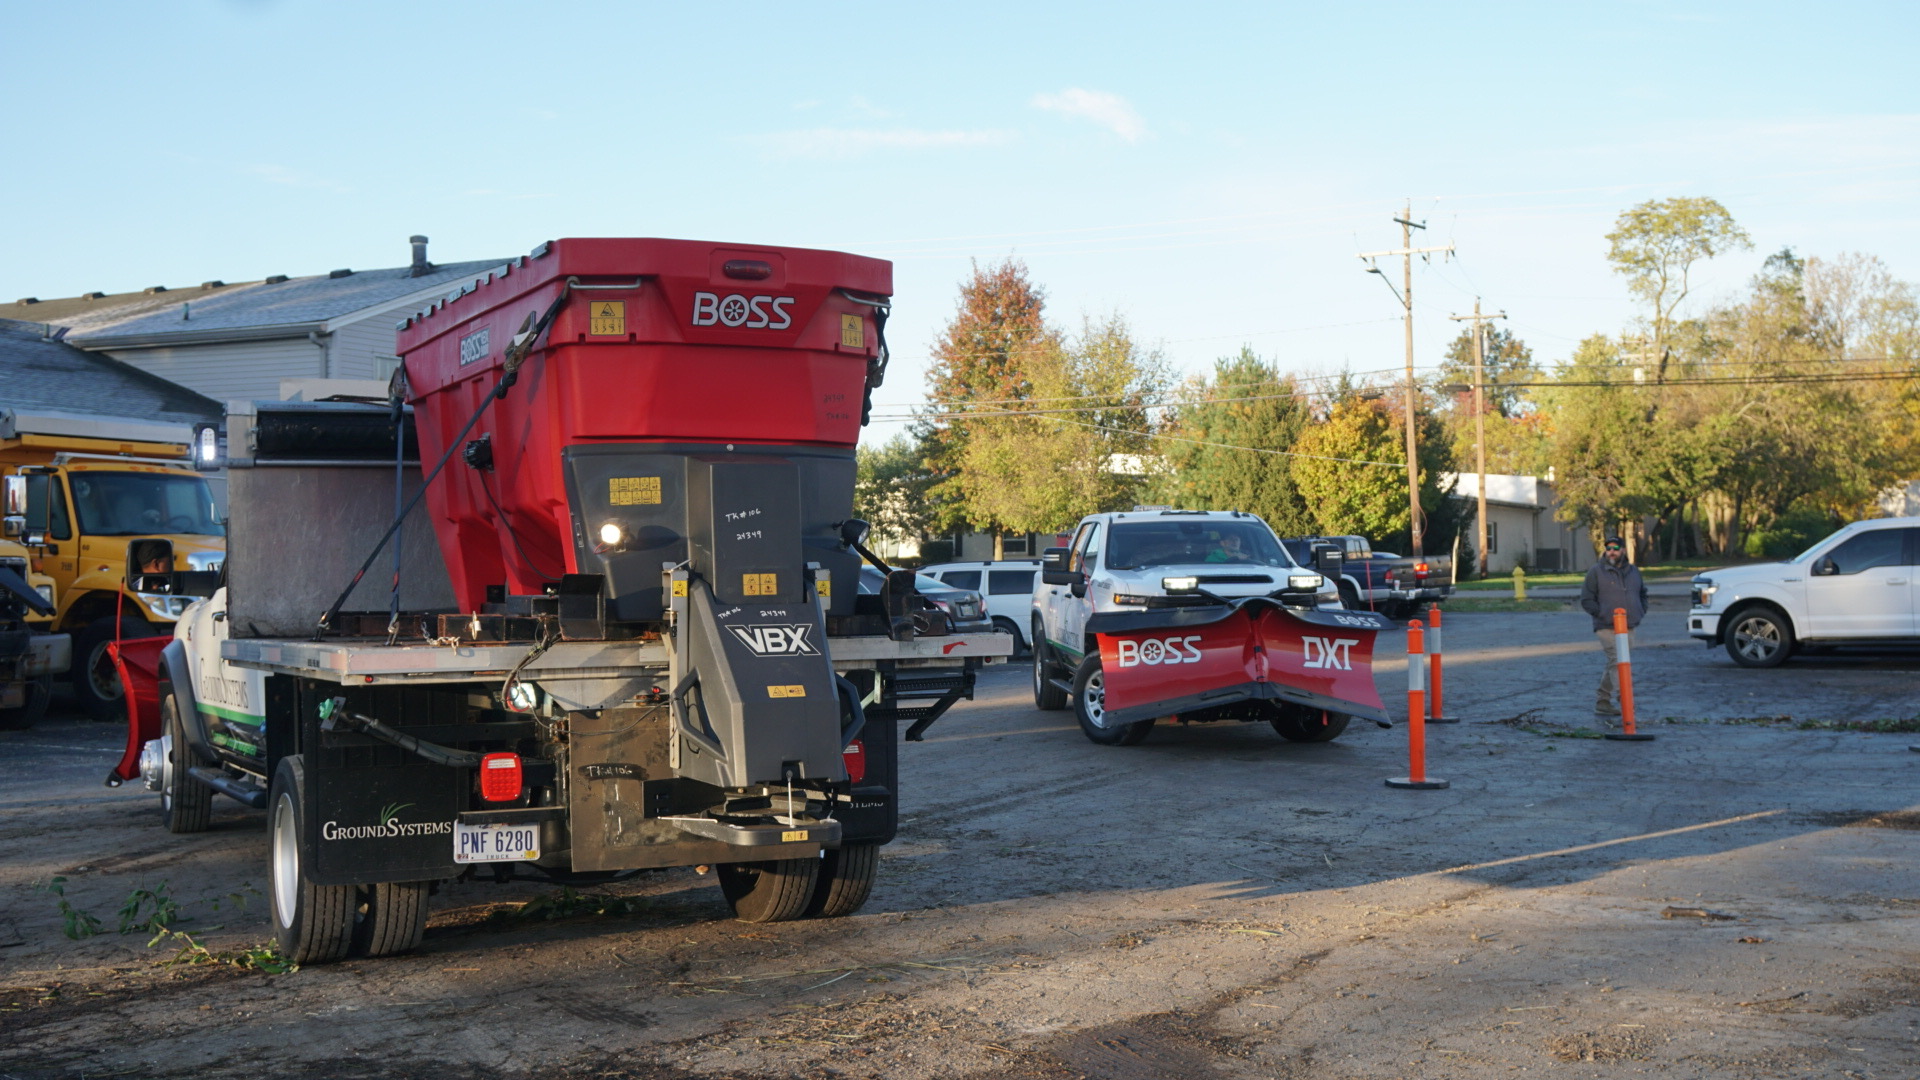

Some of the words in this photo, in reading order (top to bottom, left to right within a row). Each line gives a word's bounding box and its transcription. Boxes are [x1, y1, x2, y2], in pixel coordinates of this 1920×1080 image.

[692, 291, 795, 330] BOSS
[460, 333, 481, 366] BOSS
[736, 530, 762, 541] 24349
[1334, 615, 1382, 628] BOSS
[734, 627, 811, 653] VBX
[1118, 635, 1202, 668] BOSS
[1301, 636, 1360, 671] DXT
[461, 832, 489, 854] PNF
[495, 830, 534, 853] 6280
